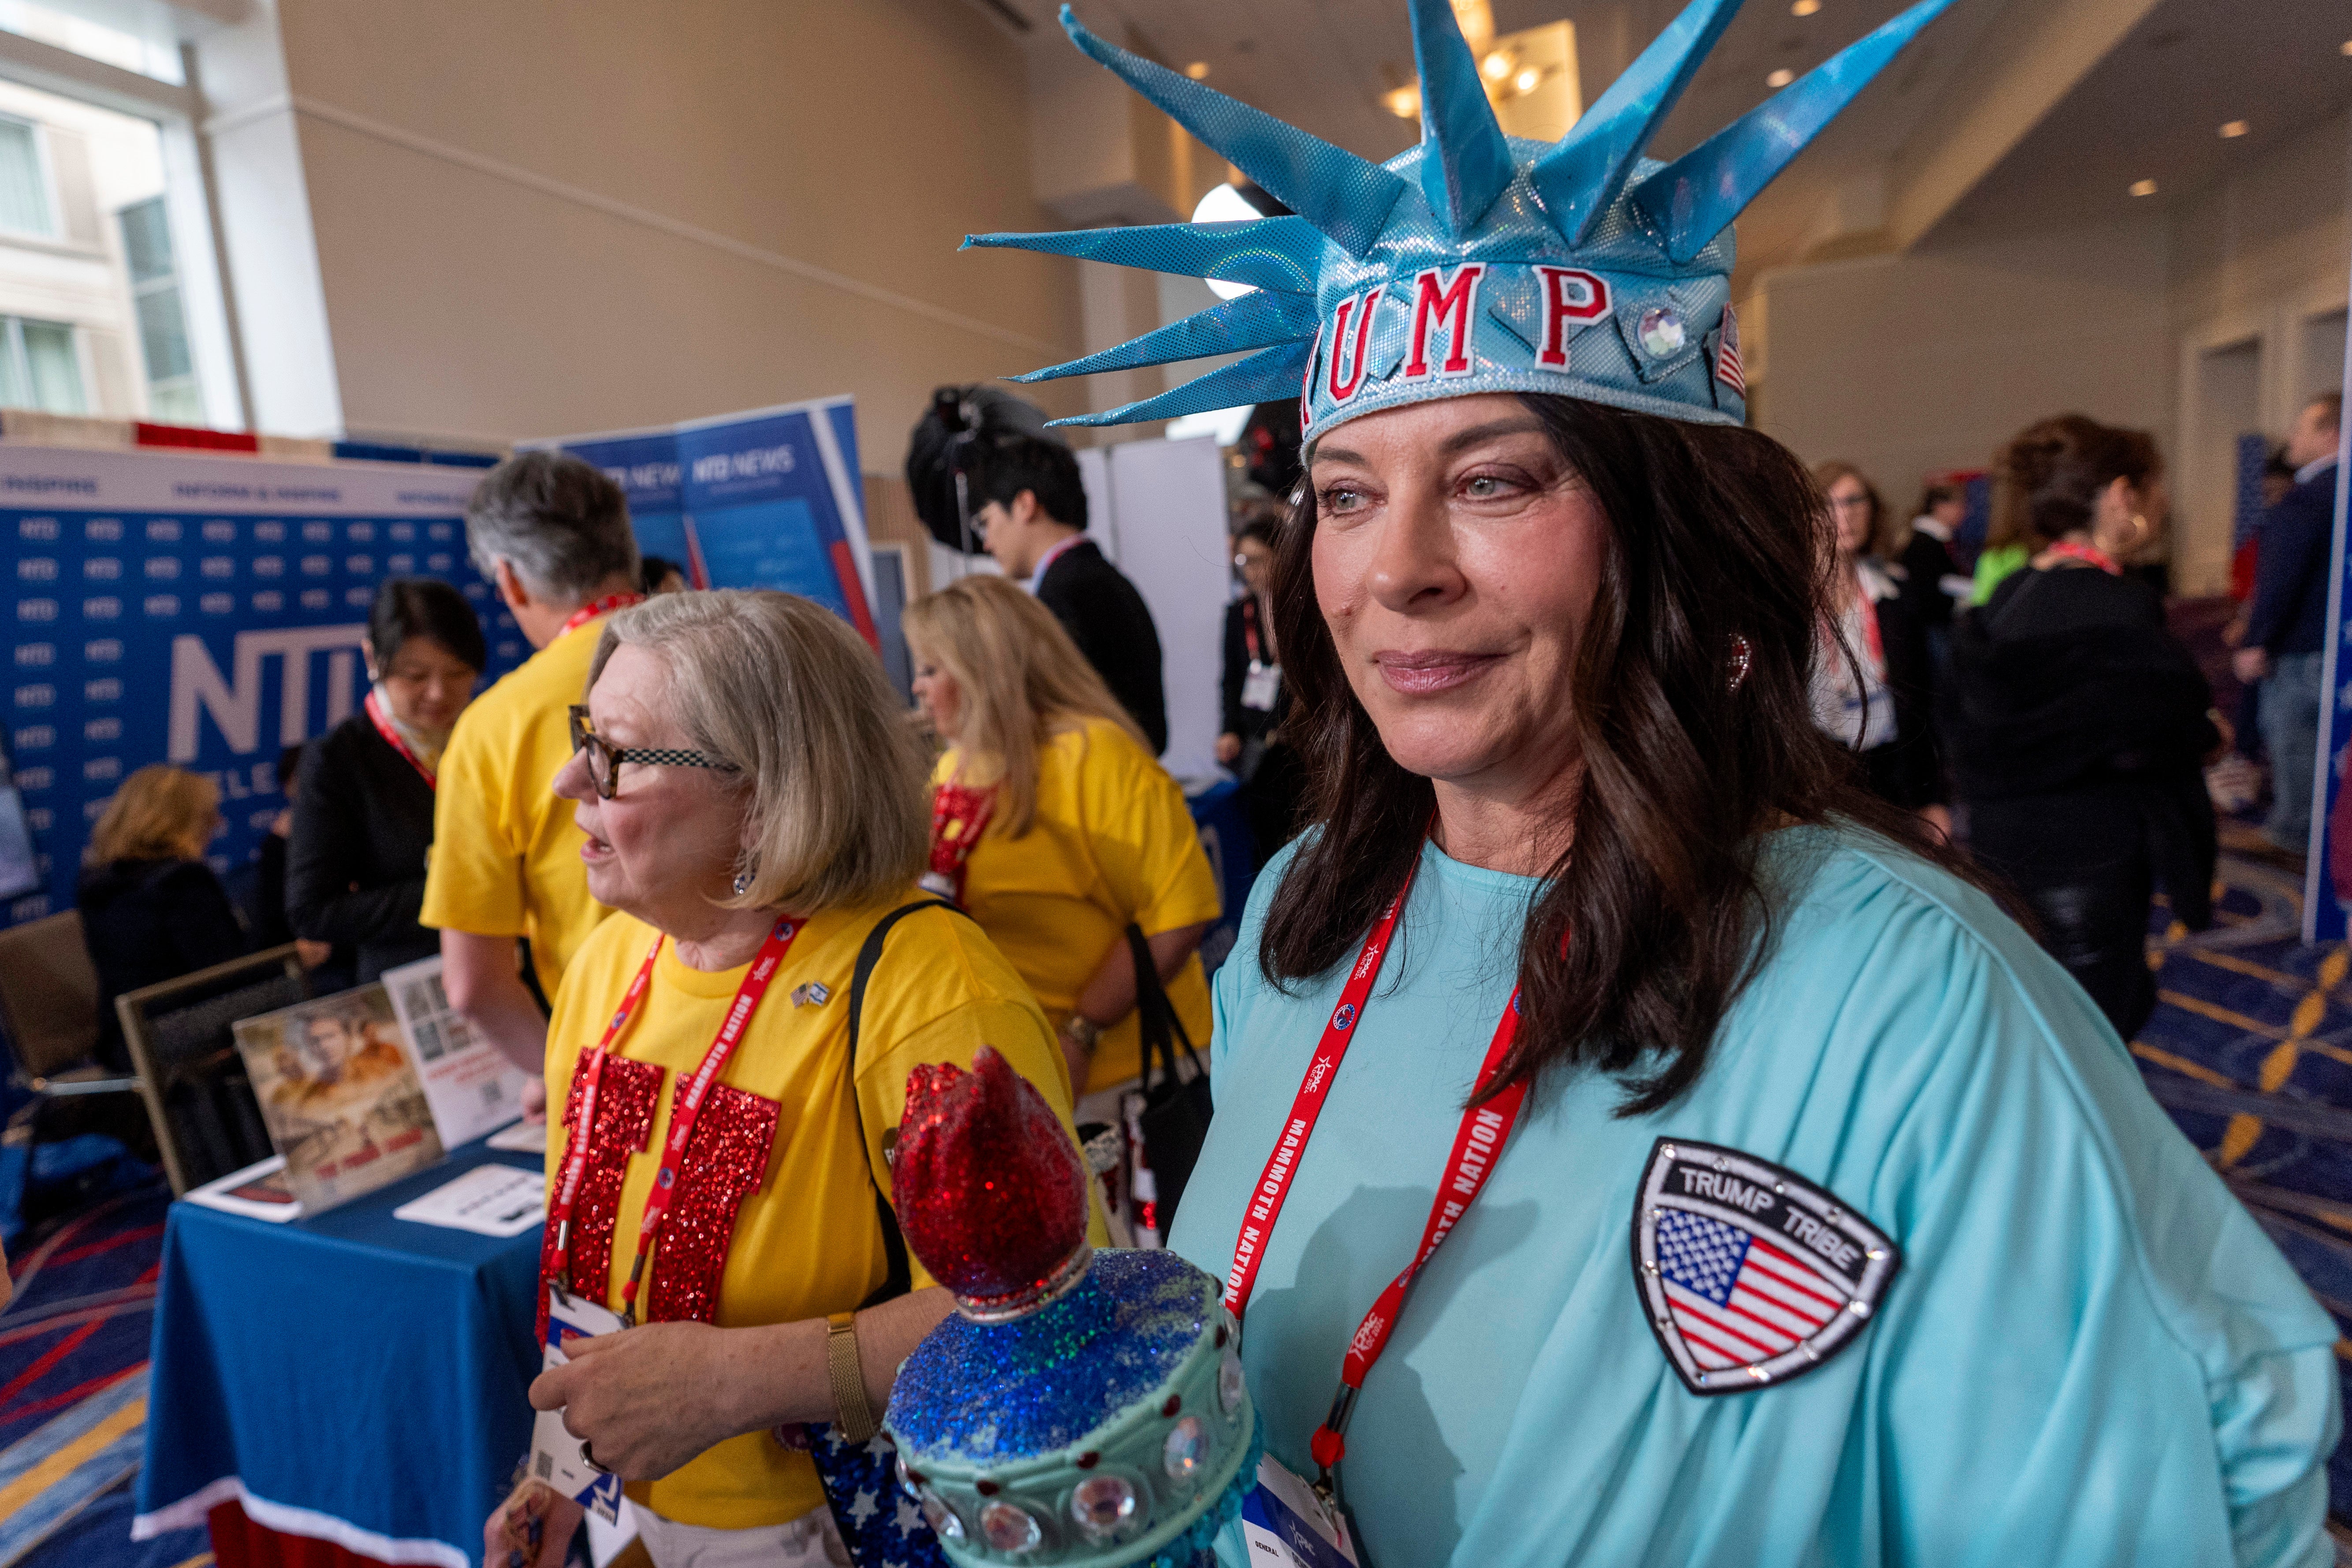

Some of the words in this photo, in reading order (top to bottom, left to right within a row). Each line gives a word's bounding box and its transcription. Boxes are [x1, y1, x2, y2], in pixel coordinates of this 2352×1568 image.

[1301, 261, 1614, 441] UMP
[732, 444, 795, 477] NEWS
[1354, 966, 1363, 980] 2024
[1359, 951, 1374, 978] CPAC
[685, 1042, 727, 1109] MAMMOTH
[722, 994, 753, 1041] NATION
[1303, 1078, 1313, 1094] 2024
[1309, 1064, 1326, 1093] CPAC
[1252, 1118, 1306, 1221] MAMMOTH
[1453, 1108, 1504, 1195] NATION
[1679, 1166, 1775, 1213] TRUMP
[1778, 1205, 1860, 1271] TRIBE
[1225, 1225, 1260, 1303] NATION
[1354, 1311, 1378, 1348] CPAC
[1255, 1540, 1279, 1557] GENERAL
